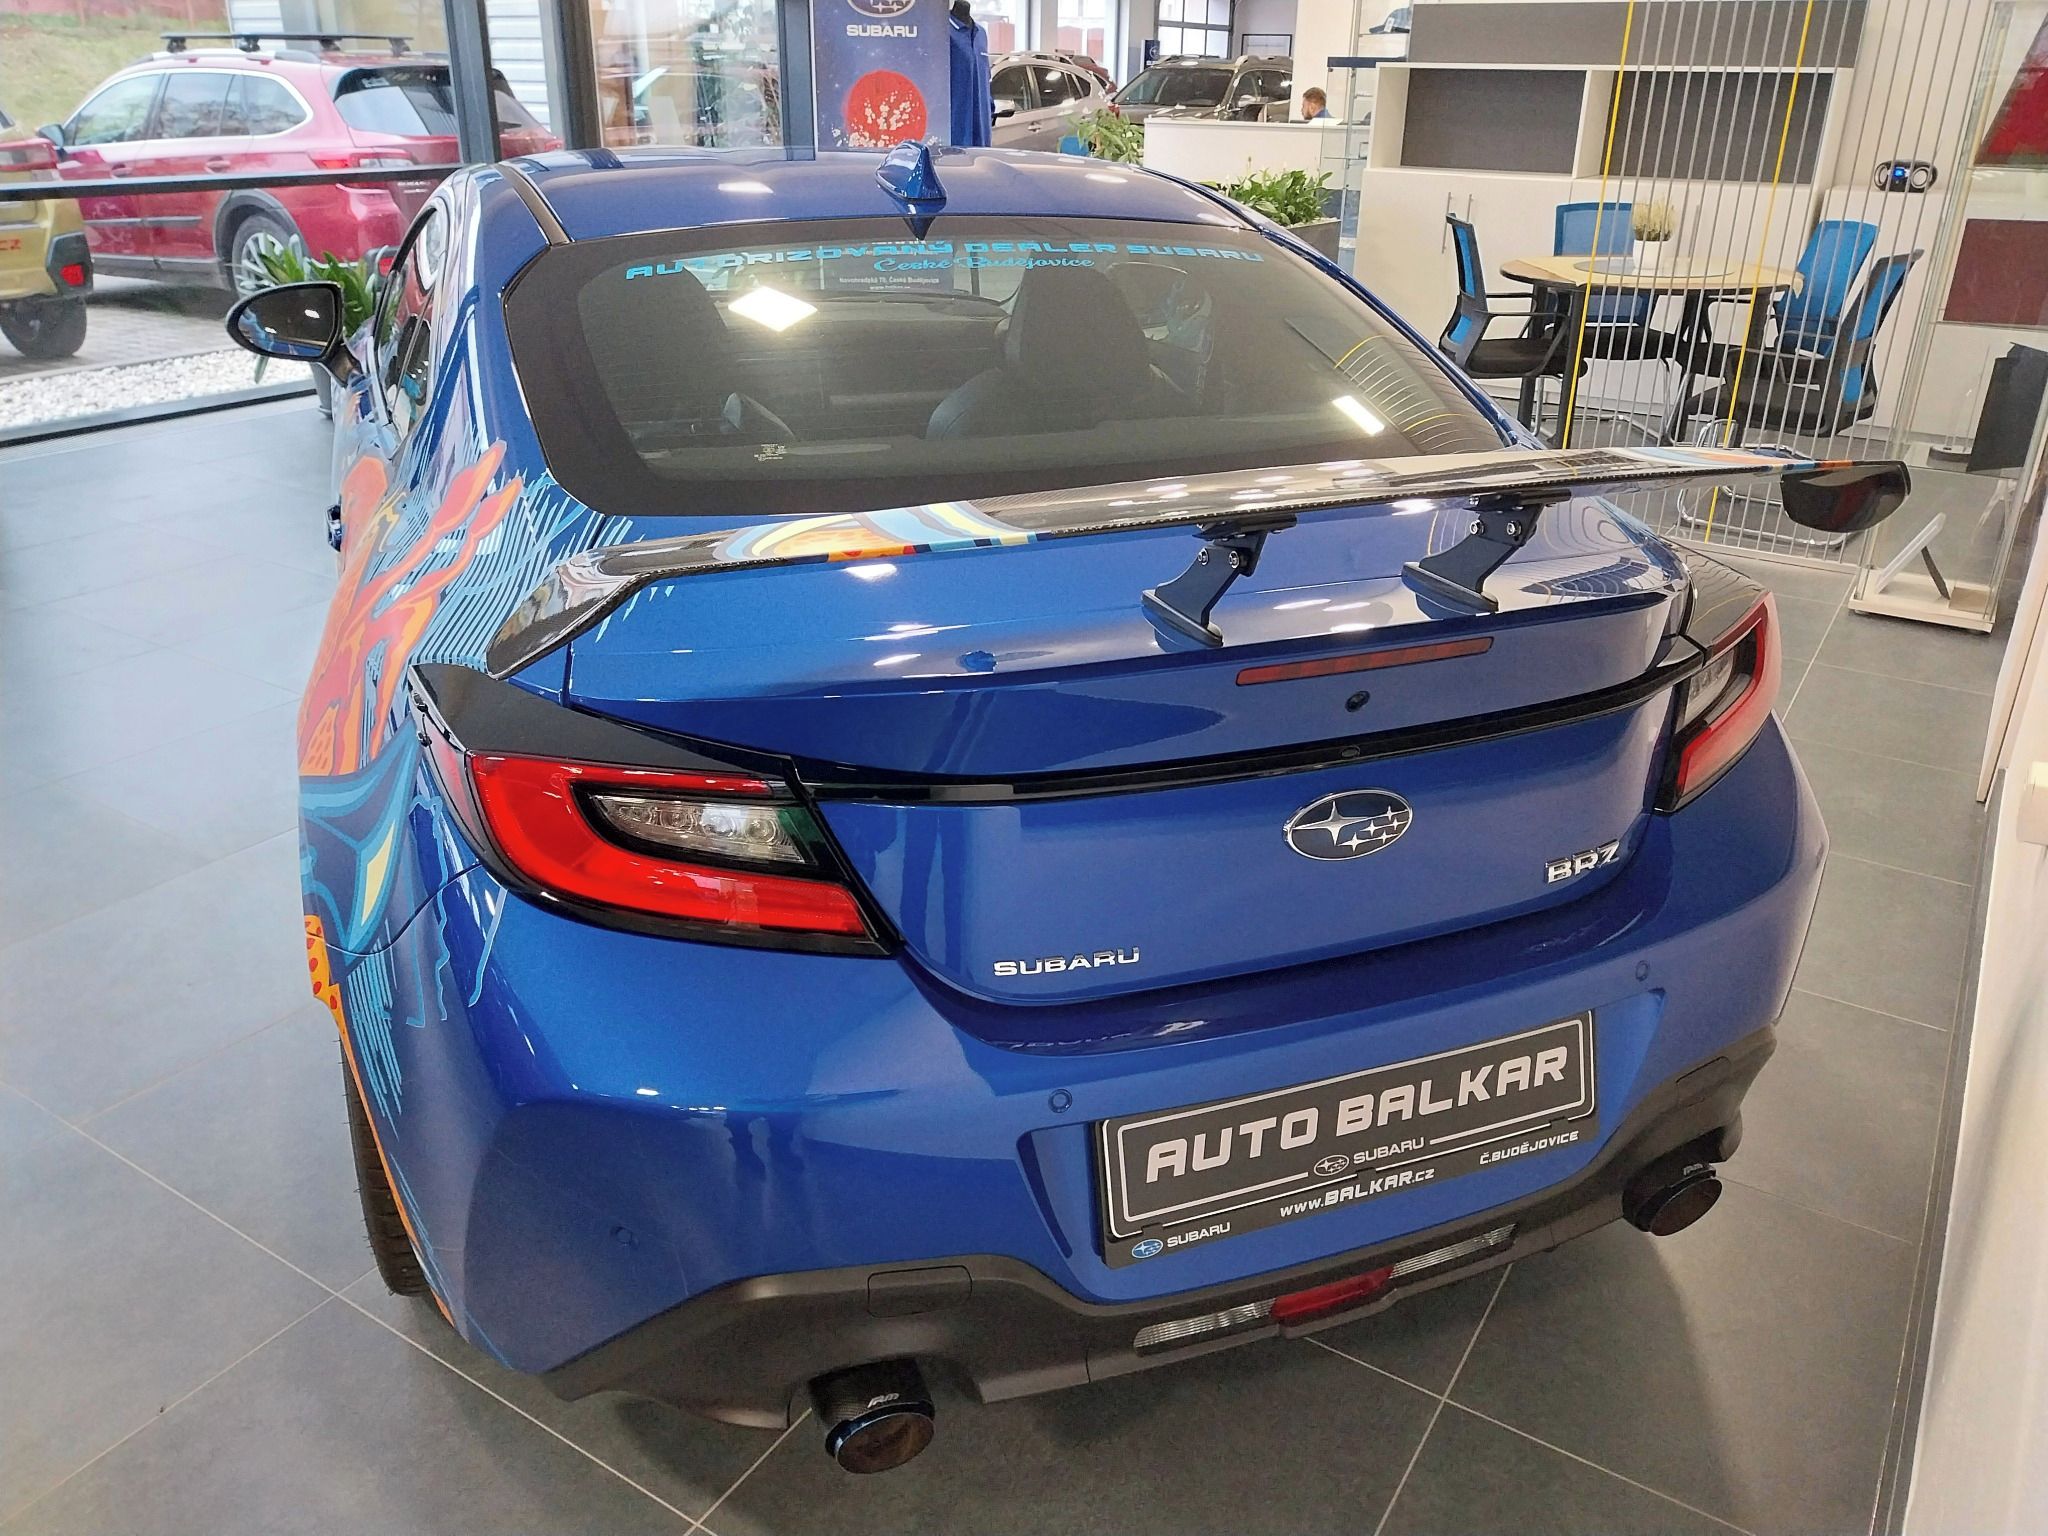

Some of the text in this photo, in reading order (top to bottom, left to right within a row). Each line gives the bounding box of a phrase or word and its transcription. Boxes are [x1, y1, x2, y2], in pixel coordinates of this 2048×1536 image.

[846, 24, 918, 38] SUBARU
[626, 241, 953, 280] AUTORIZOVANÝ
[963, 242, 1118, 254] DEALER
[1126, 245, 1264, 262] SUBARU
[1544, 839, 1620, 884] BRZ
[994, 947, 1140, 976] SUBARU
[1145, 1046, 1568, 1184] AUTO BALKAR
[1353, 1136, 1425, 1165] SUBARU
[1480, 1131, 1579, 1165] Č.BUDĚJOVICE
[1280, 1168, 1435, 1217] www.BALKAR.cz
[1167, 1222, 1231, 1248] SUBARU
